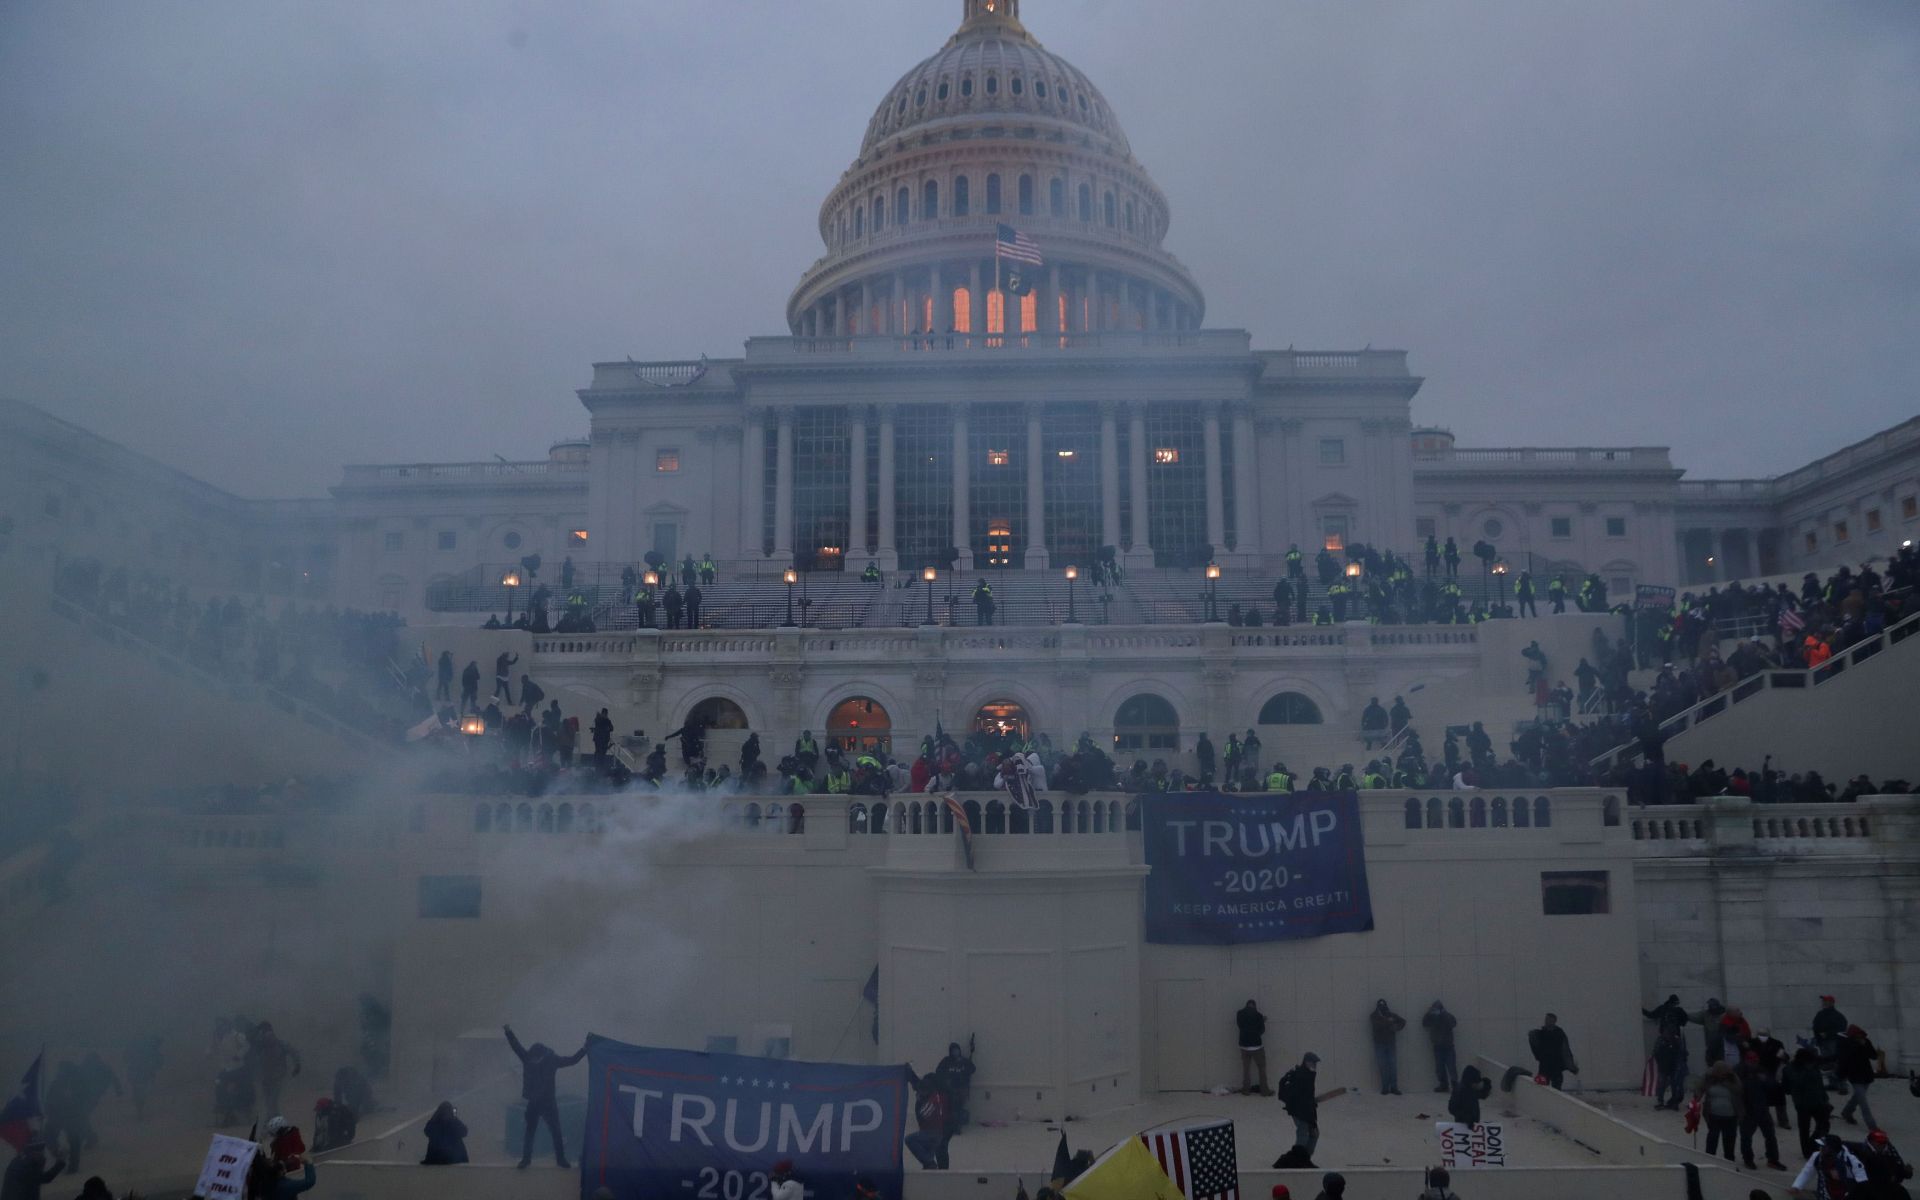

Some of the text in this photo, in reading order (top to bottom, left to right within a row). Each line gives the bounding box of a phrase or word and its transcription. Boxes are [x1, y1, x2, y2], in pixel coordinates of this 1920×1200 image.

[1166, 809, 1337, 857] TRUMP
[1173, 903, 1212, 916] KEEP
[1217, 899, 1287, 915] AMERICA
[618, 1084, 884, 1153] TRUMP
[1441, 1127, 1455, 1168] VOTE
[1454, 1132, 1473, 1158] MY
[1472, 1125, 1486, 1166] STEAL
